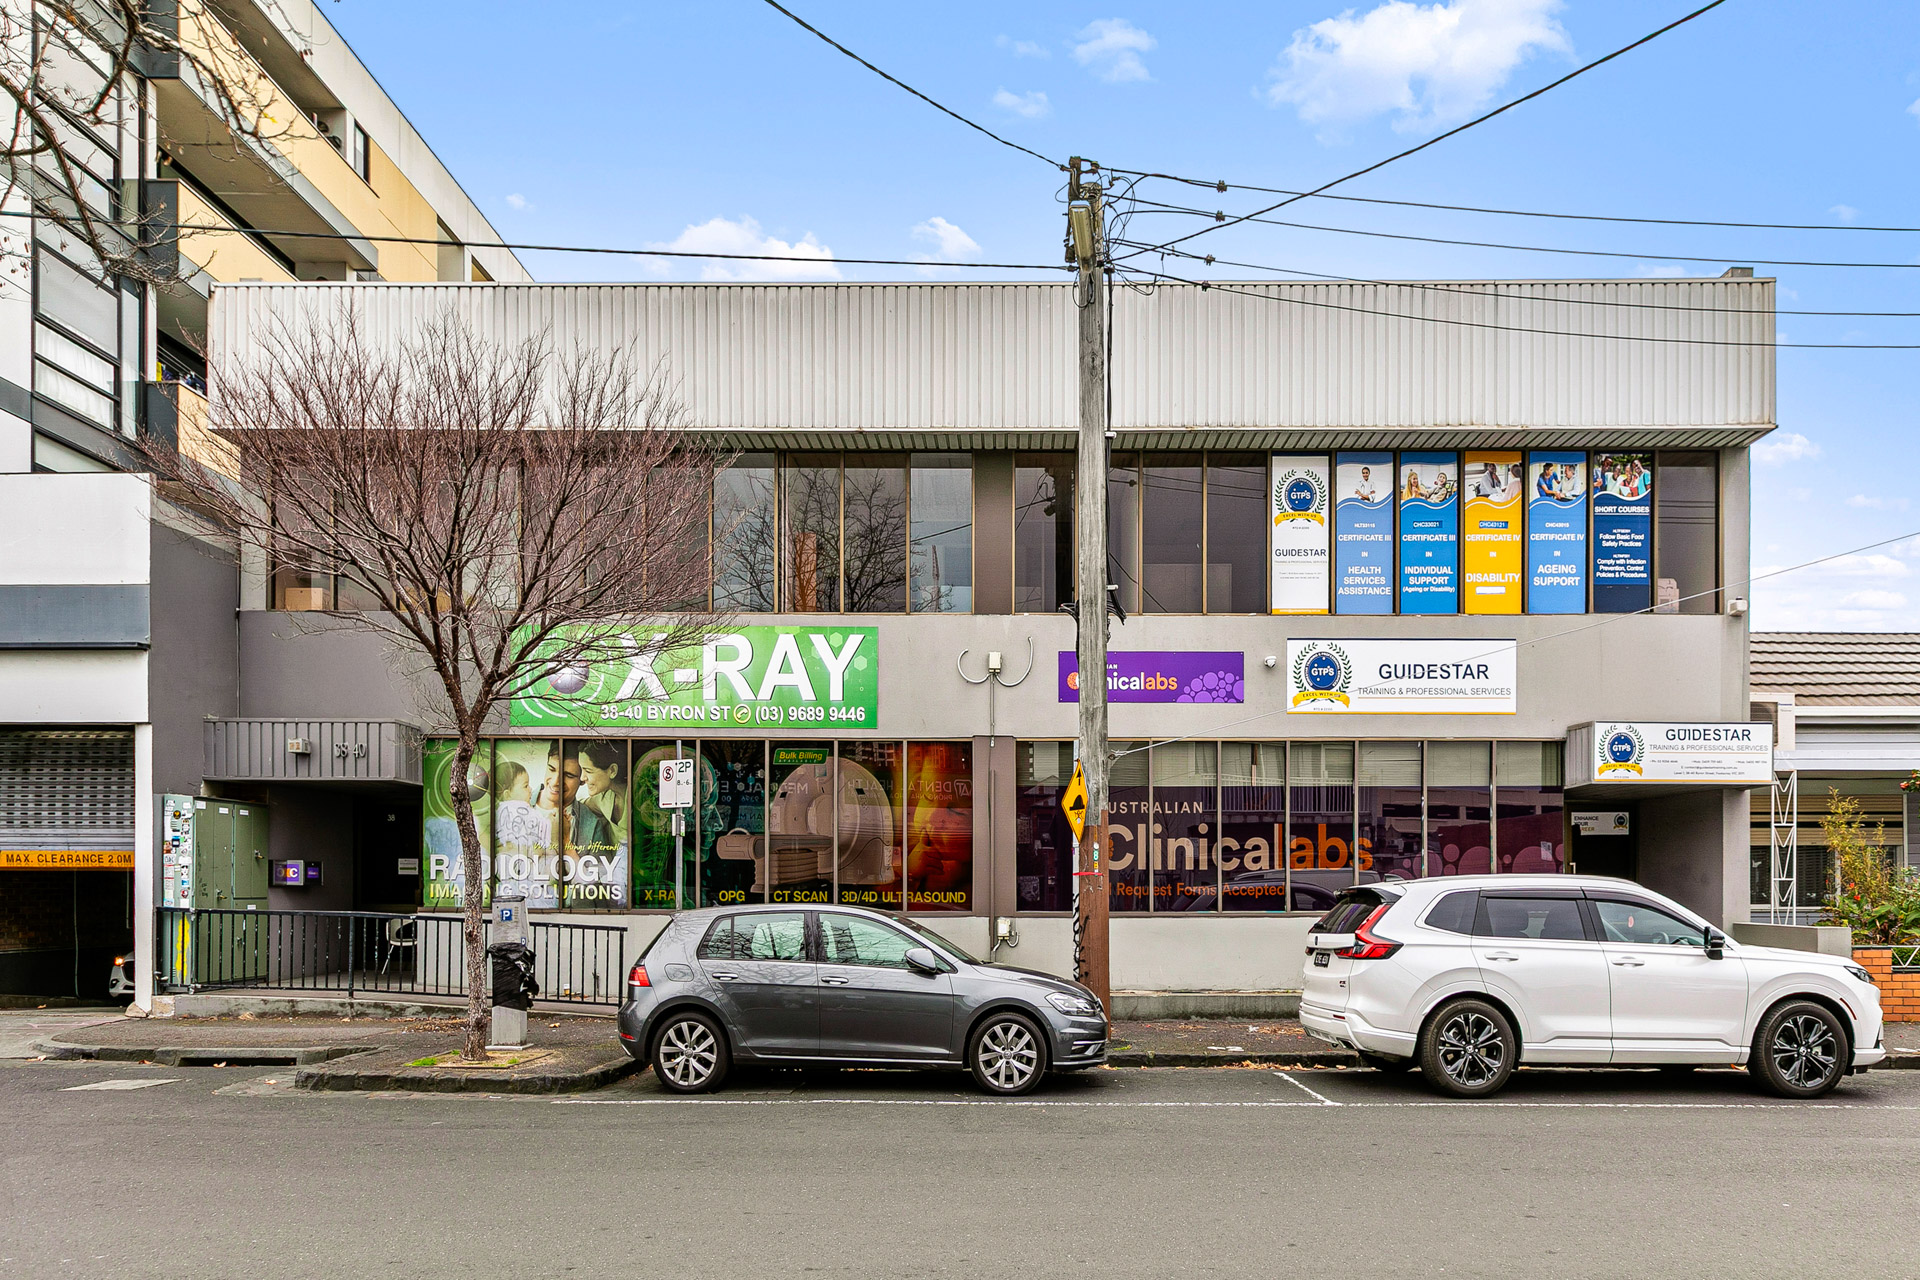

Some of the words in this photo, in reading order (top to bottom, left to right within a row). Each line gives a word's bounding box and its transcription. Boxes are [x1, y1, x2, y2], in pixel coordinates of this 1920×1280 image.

[1530, 533, 1576, 541] CERTIFICATE
[1577, 533, 1584, 541] IV
[1275, 548, 1327, 557] GUIDESTAR
[1348, 566, 1381, 574] HEALTH
[1404, 566, 1454, 574] INDIVIDUAL
[1537, 564, 1577, 574] AGEING
[1343, 576, 1386, 585] SERVICES
[1408, 576, 1449, 585] SUPPORT
[1466, 573, 1520, 583] DISABILITY
[1533, 576, 1580, 586] SUPPORT
[1338, 586, 1391, 595] ASSISTANCE
[615, 633, 866, 702] X-RAY
[1311, 667, 1335, 676] GTPS
[1378, 664, 1489, 680] GUIDESTAR
[1358, 687, 1397, 696] TRAINING
[1405, 687, 1469, 696] PROFESSIONAL
[1470, 687, 1511, 696] SERVICES
[600, 705, 643, 721] 38-40
[647, 705, 705, 721] BYRON
[709, 705, 731, 721] ST
[755, 705, 784, 724] (03)
[788, 706, 825, 722] 9689
[829, 706, 866, 722] 9446
[1665, 729, 1751, 741] GUIDESTAR
[779, 752, 797, 760] Bulk
[798, 752, 823, 761] Billing
[678, 761, 692, 773] 2P
[1108, 801, 1203, 814] USTRALIAN
[565, 841, 585, 854] things
[587, 840, 624, 853] differently
[1108, 823, 1374, 872] Clinicalabs
[6, 854, 33, 863] MAX.
[37, 854, 104, 863] CLEARANCE
[108, 854, 132, 863] 2.0M
[519, 884, 623, 900] SOLUTIONS
[644, 890, 677, 901] X-RA
[1117, 882, 1172, 899] Request
[1176, 882, 1217, 896] Forms
[1222, 882, 1286, 899] Accepted
[718, 890, 746, 902] OPG
[773, 890, 791, 902] CT
[793, 890, 828, 903] SCAN
[841, 890, 878, 903] 3D/4D
[882, 891, 967, 903] ULTRASOUND
[503, 910, 511, 920] P
